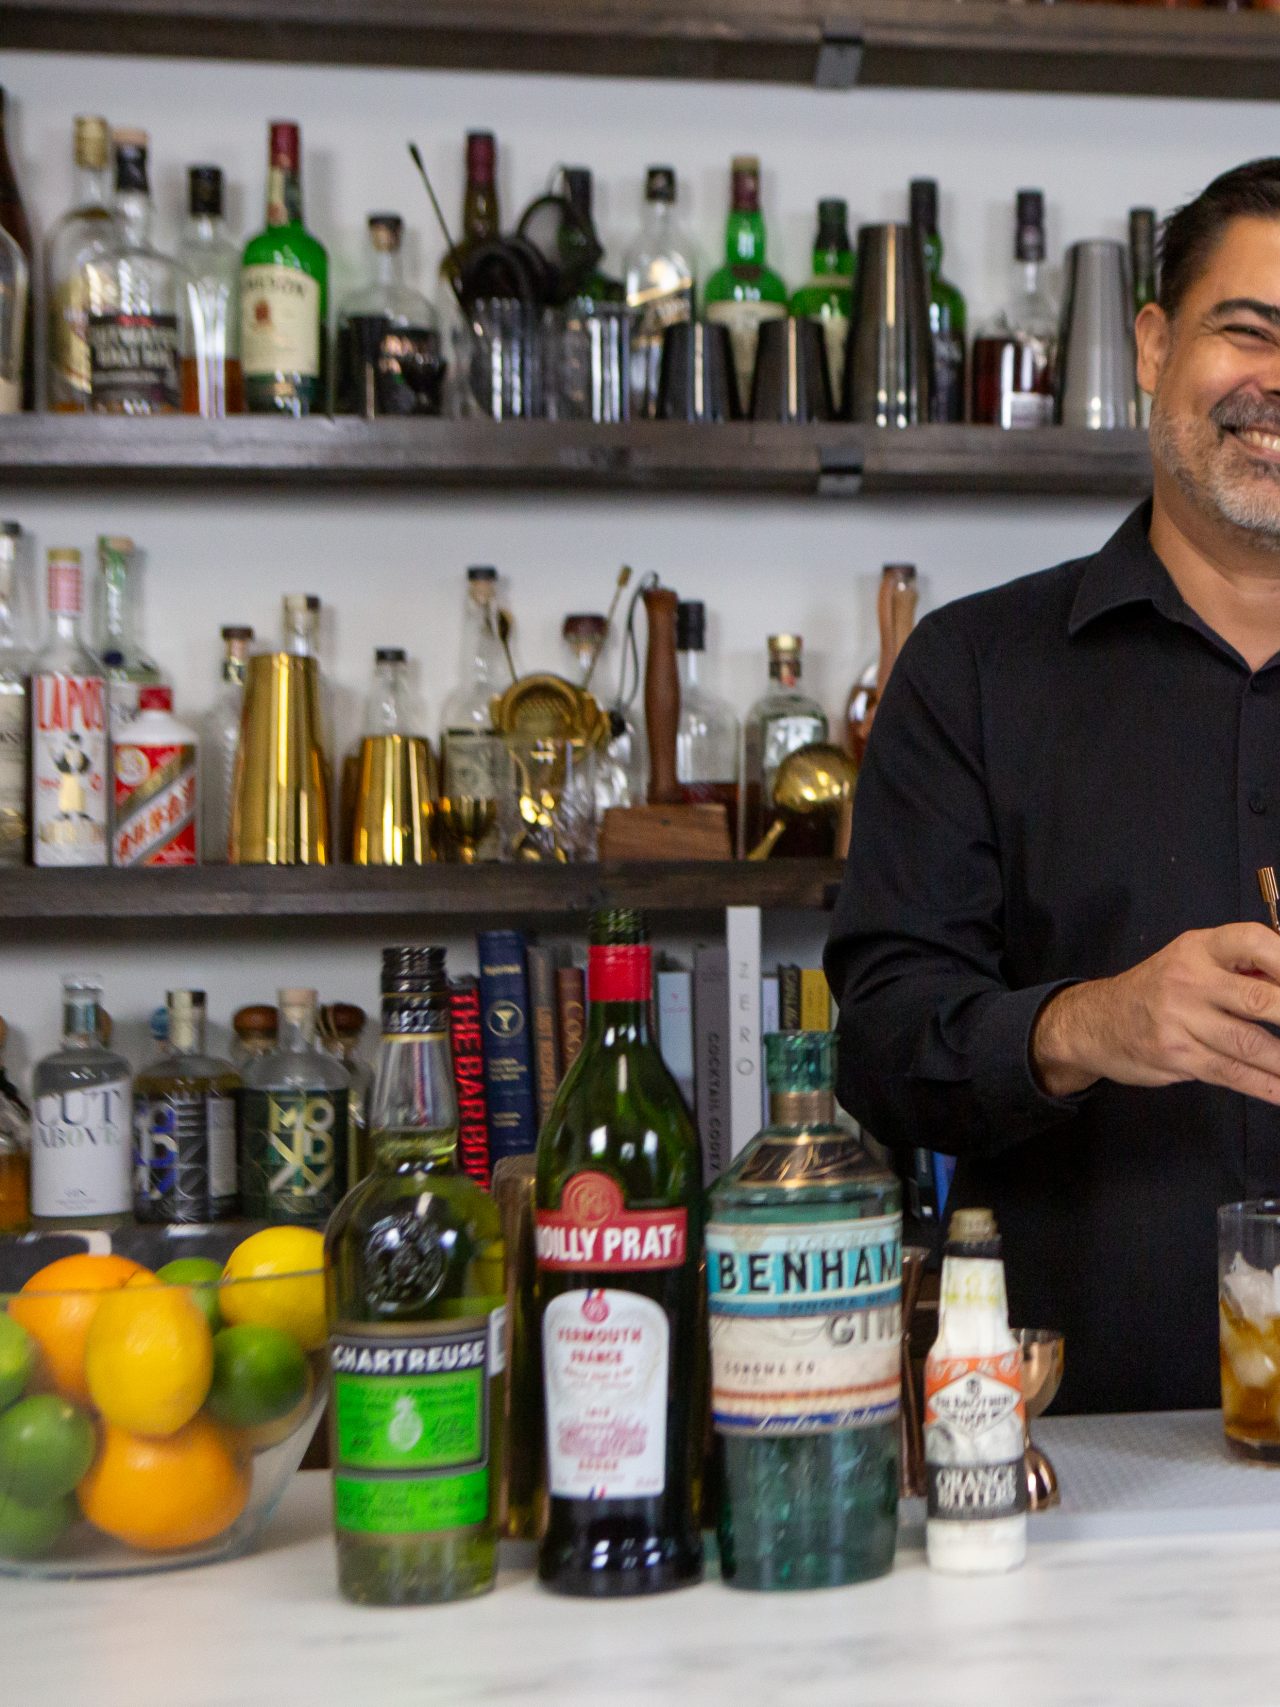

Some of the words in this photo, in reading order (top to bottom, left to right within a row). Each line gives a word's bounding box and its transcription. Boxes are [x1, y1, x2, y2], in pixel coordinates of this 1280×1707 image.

[450, 988, 482, 1053] THE
[454, 1056, 487, 1119] BAR
[37, 1089, 122, 1126] CUT
[461, 1124, 491, 1193] BOO
[602, 1223, 676, 1262] PRAT
[331, 1339, 486, 1374] CHARTREUSE
[936, 1467, 1016, 1488] ORANGE
[937, 1485, 1016, 1510] BITTERS
